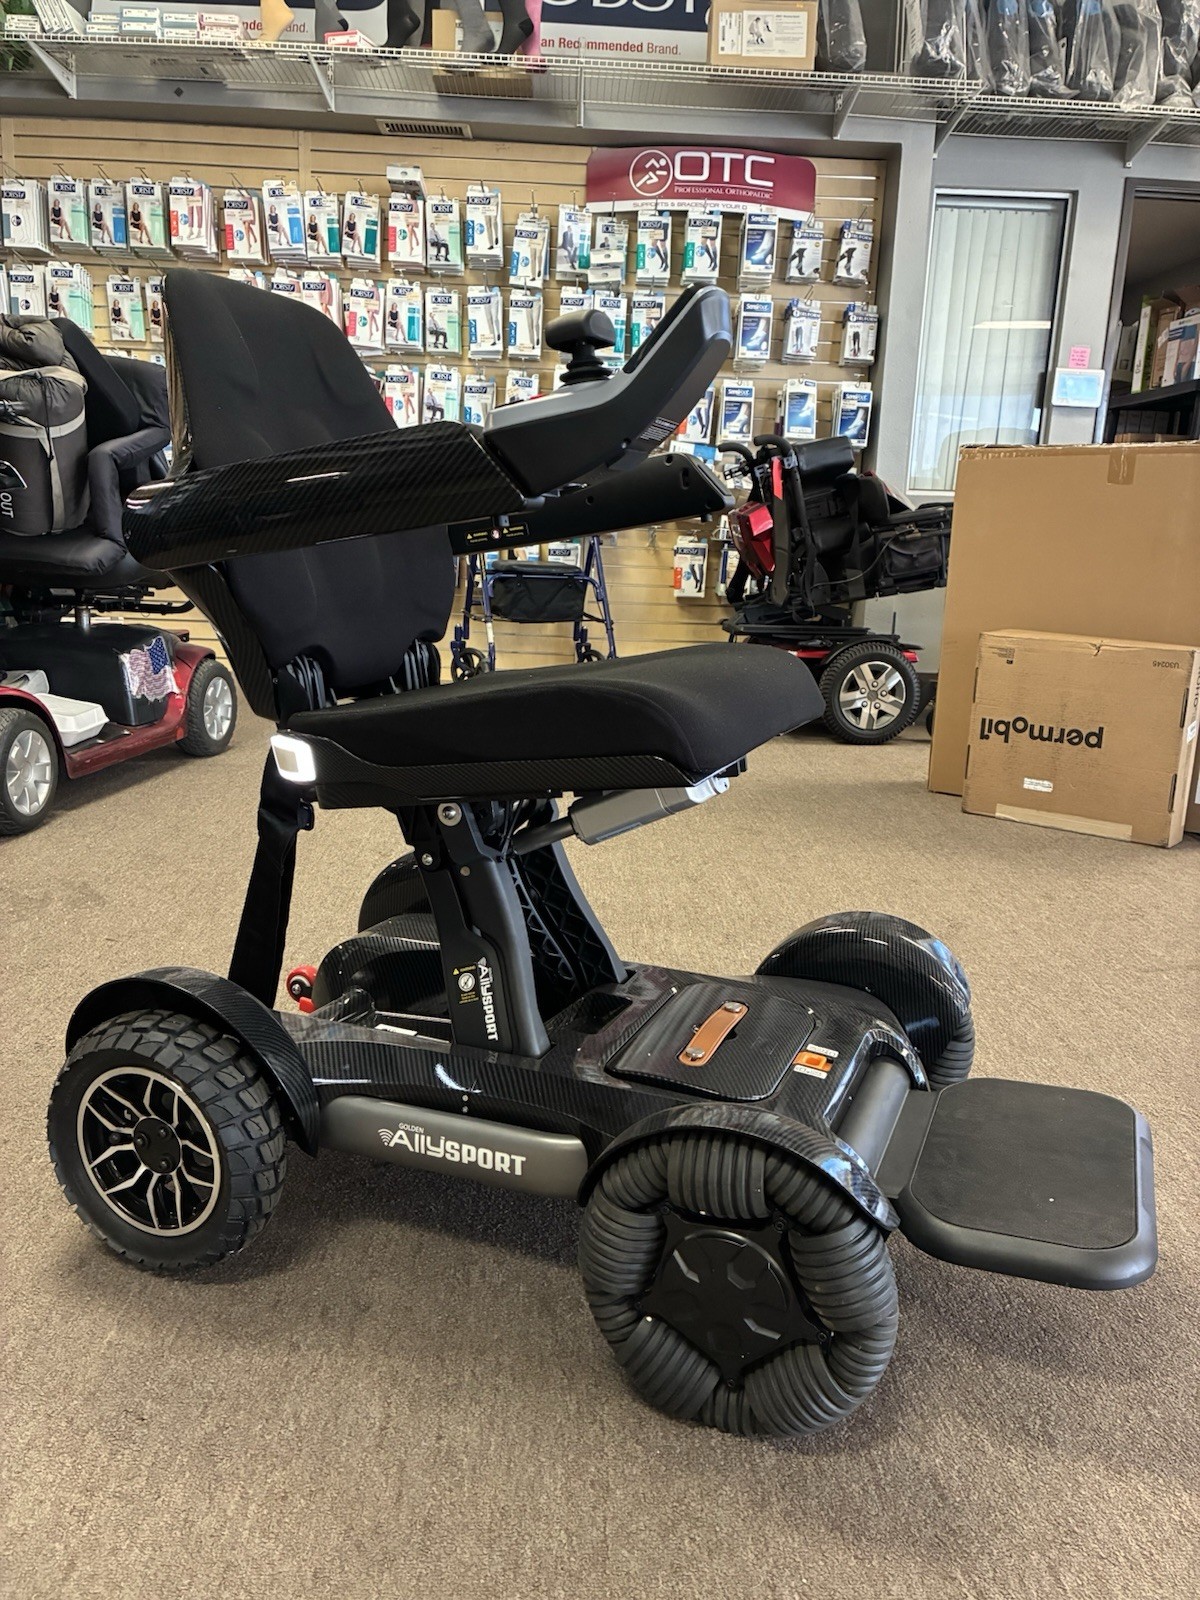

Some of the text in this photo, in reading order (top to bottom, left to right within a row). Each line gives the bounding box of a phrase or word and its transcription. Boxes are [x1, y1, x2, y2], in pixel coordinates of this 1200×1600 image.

[558, 37, 643, 53] Recmmended
[646, 42, 682, 56] Brand.
[674, 151, 775, 187] OTC
[0, 492, 14, 518] OUT
[979, 716, 1104, 749] permobil
[398, 1122, 425, 1134] GOLDEN
